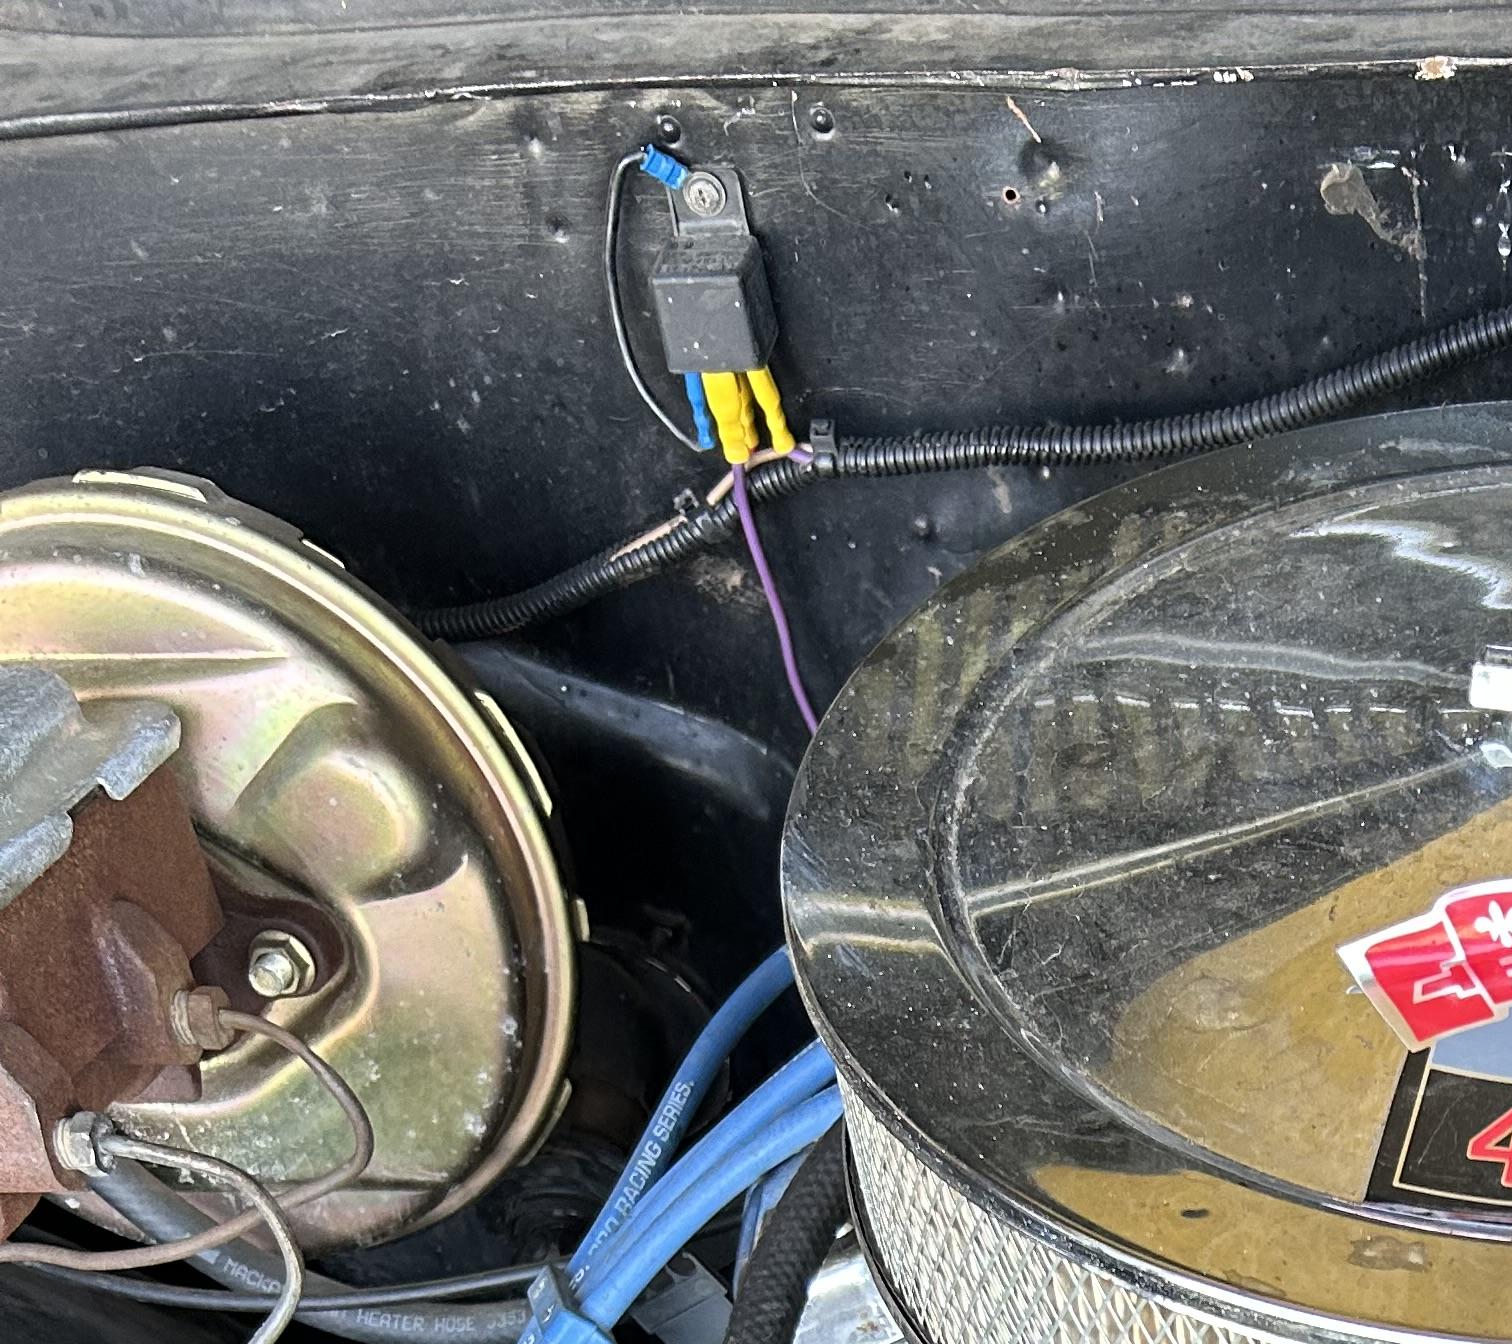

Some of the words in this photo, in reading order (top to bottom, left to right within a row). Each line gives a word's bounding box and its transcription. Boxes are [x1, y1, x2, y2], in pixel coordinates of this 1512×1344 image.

[614, 1139, 662, 1221] RACING
[355, 1308, 425, 1332] HEATER
[434, 1313, 476, 1332] HOSE
